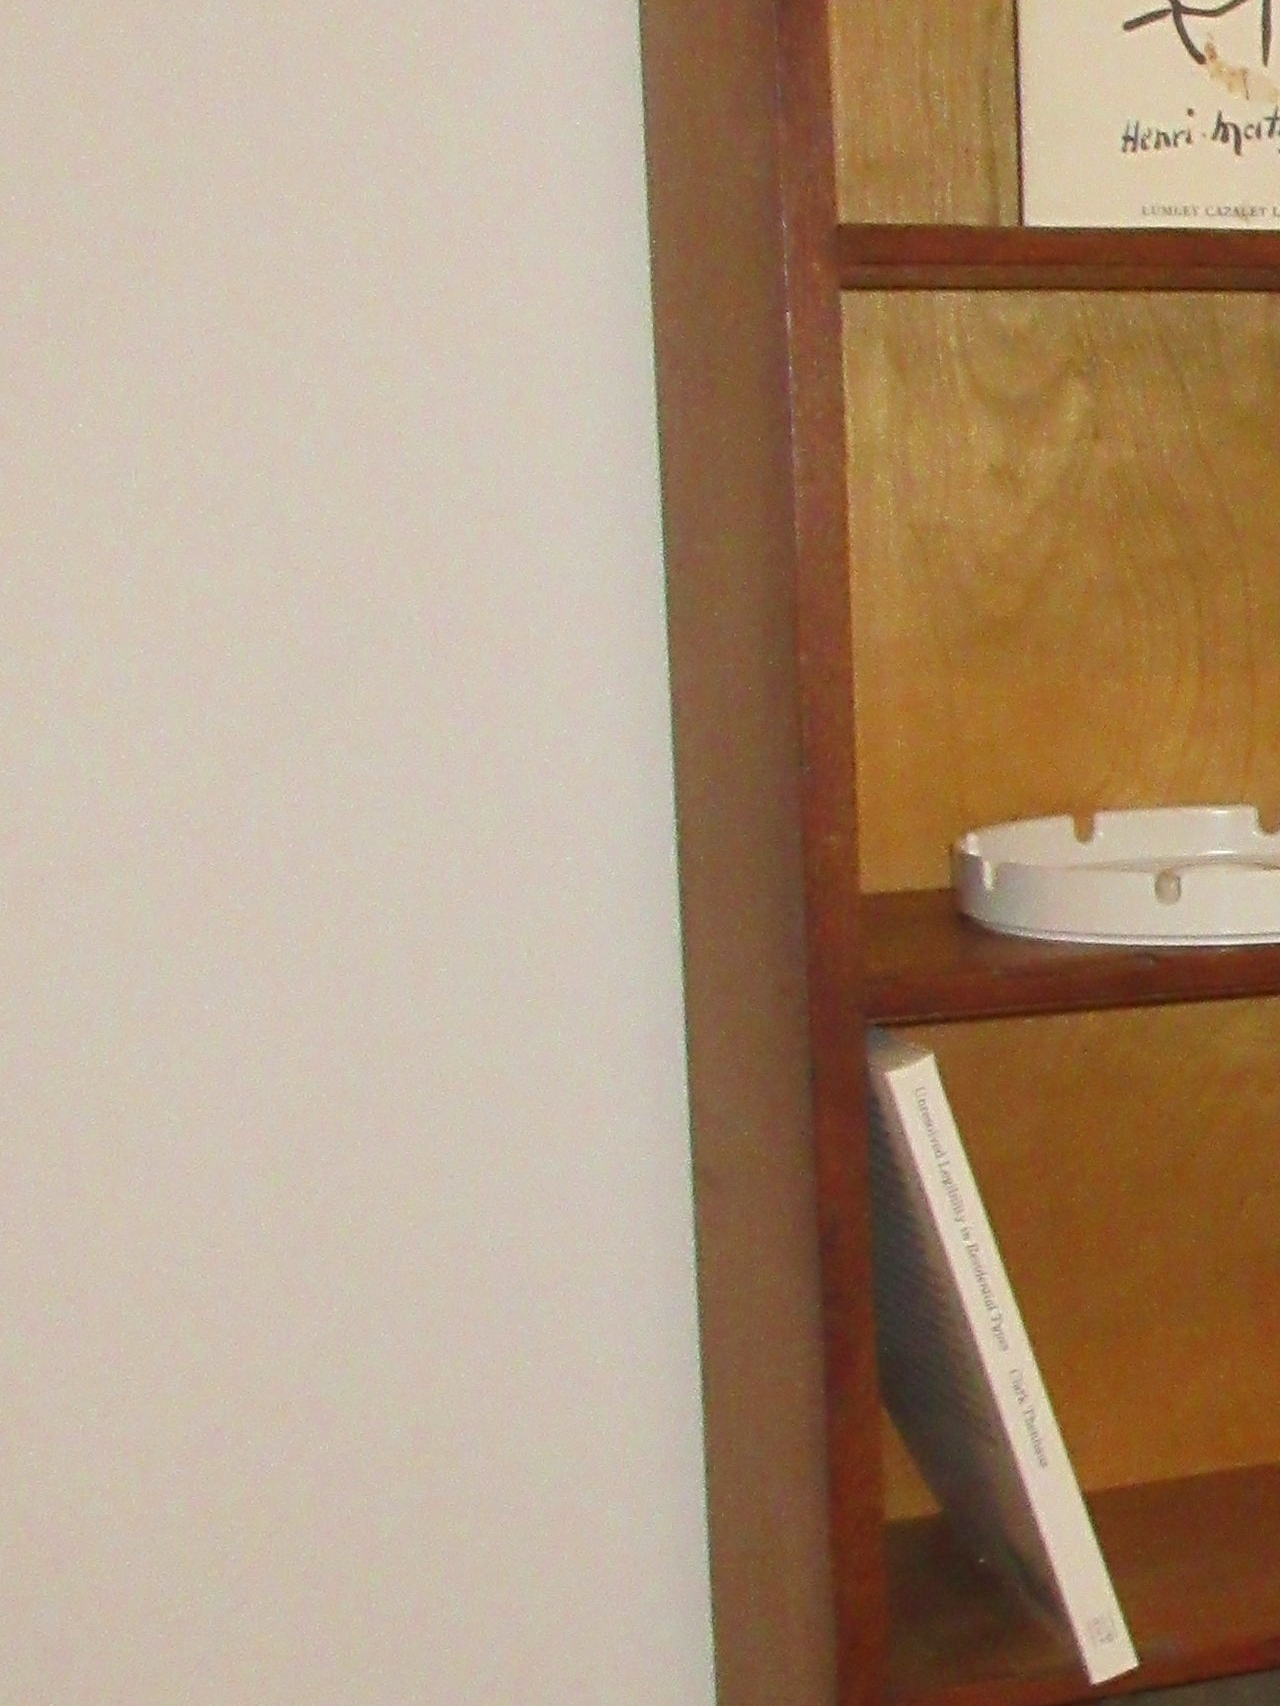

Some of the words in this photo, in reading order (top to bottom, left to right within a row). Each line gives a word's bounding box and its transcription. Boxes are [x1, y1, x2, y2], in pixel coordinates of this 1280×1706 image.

[1121, 108, 1194, 153] Henri
[1142, 204, 1200, 218] LUMLEY
[1205, 205, 1268, 219] CAZALET
